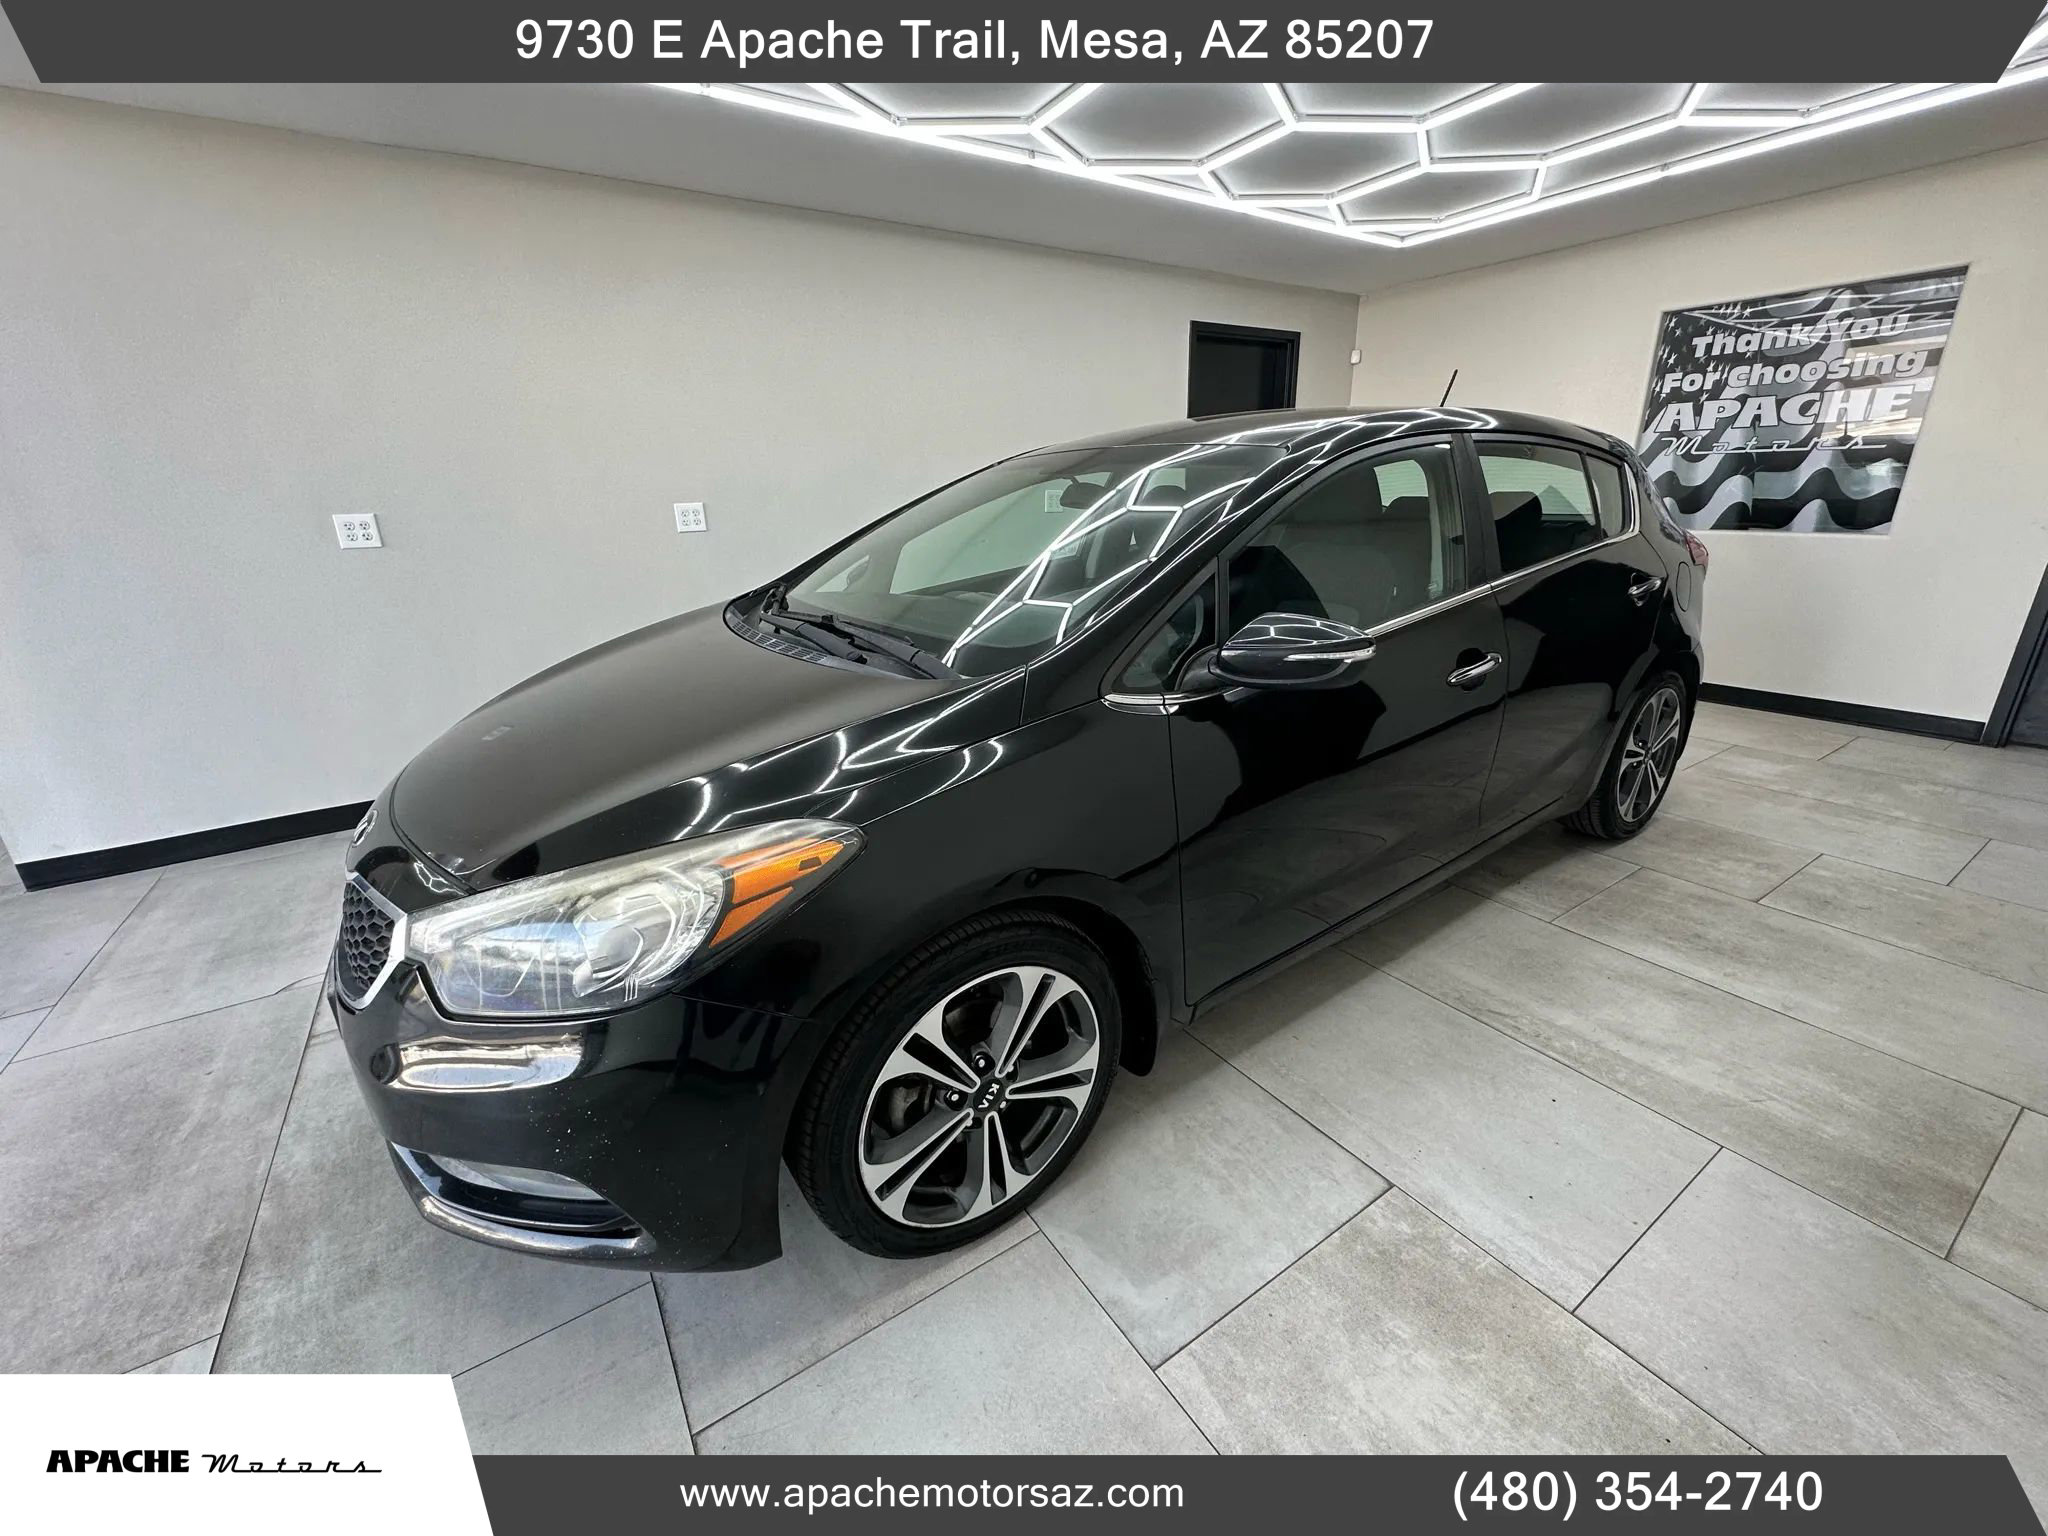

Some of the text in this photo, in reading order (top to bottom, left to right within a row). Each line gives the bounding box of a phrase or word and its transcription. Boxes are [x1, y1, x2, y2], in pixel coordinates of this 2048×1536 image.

[1691, 313, 1911, 359] Thank You
[1661, 370, 1721, 394] For
[1653, 384, 1916, 433] APACHE
[1659, 434, 1887, 457] Motors
[977, 1082, 1000, 1109] KIA
